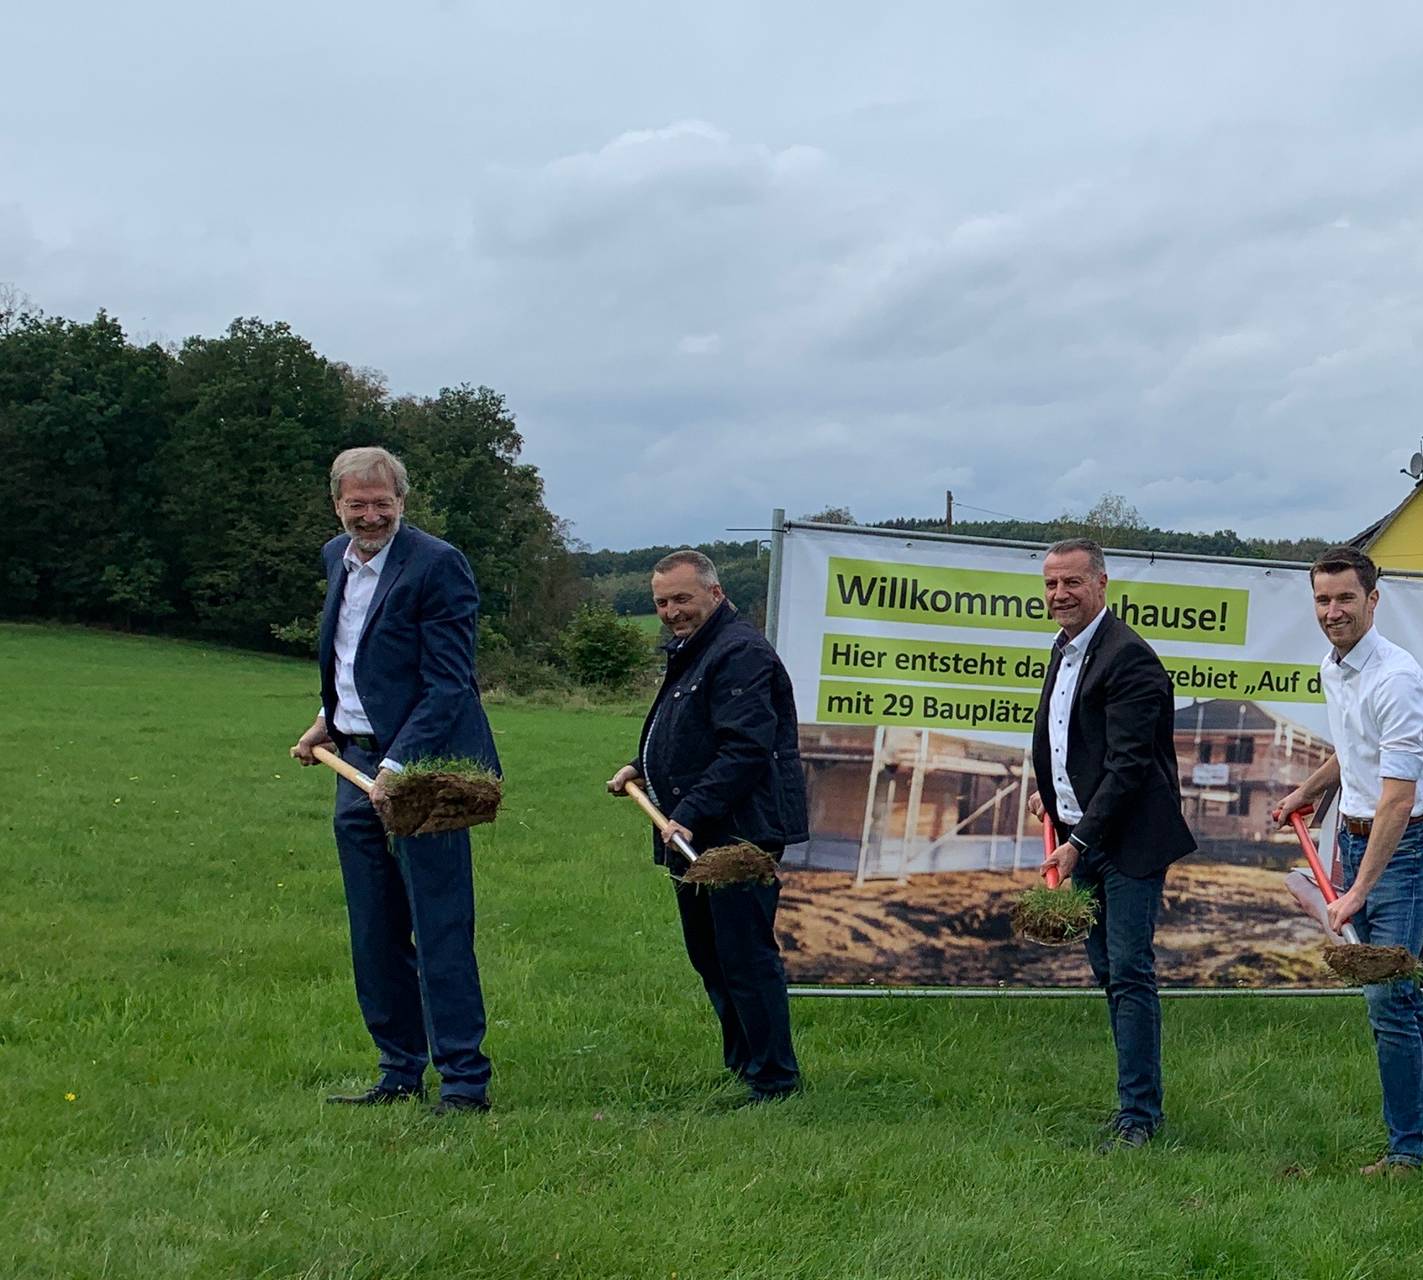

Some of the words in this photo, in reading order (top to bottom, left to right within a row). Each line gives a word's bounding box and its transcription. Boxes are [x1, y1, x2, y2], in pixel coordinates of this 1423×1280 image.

[836, 573, 1053, 620] Willkomme
[831, 643, 887, 669] Hier
[895, 651, 1007, 677] entsteht
[1014, 655, 1046, 679] da
[1243, 670, 1301, 695] „Auf
[827, 691, 874, 715] mit
[882, 693, 914, 717] 29
[923, 696, 1037, 726] Bauplätz
